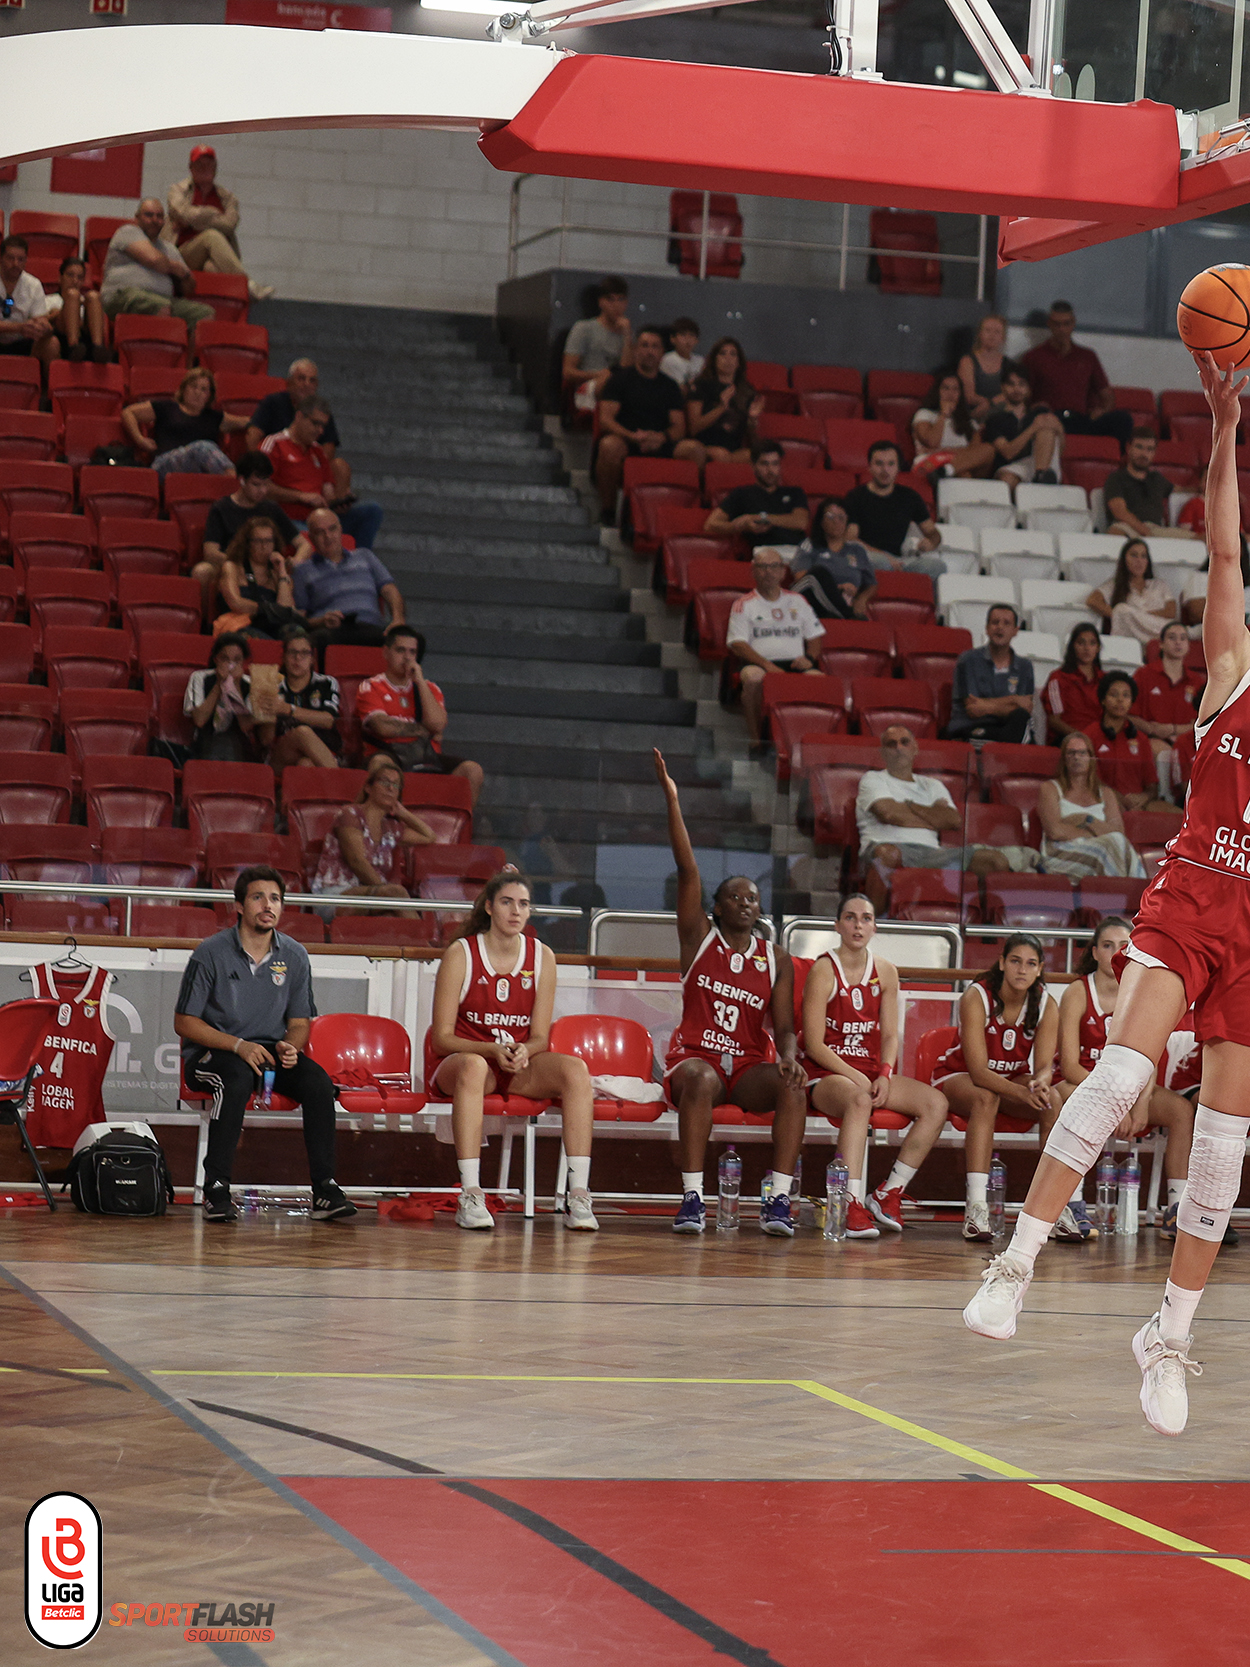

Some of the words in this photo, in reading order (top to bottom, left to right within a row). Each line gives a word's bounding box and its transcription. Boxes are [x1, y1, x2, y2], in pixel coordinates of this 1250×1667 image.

[1217, 733, 1242, 760] SL
[697, 974, 712, 989] SL
[712, 981, 765, 1011] BENFICA
[466, 1011, 482, 1024] SL
[713, 1000, 740, 1032] 33
[842, 1021, 880, 1033] BENF
[43, 1035, 98, 1056] BENFICA
[50, 1051, 65, 1079] 4
[988, 1059, 1028, 1071] BENF
[41, 1083, 75, 1099] LOBAL
[105, 1080, 148, 1089] ISTEMAS
[150, 1082, 179, 1090] DIGITA
[41, 1096, 75, 1111] AGEM
